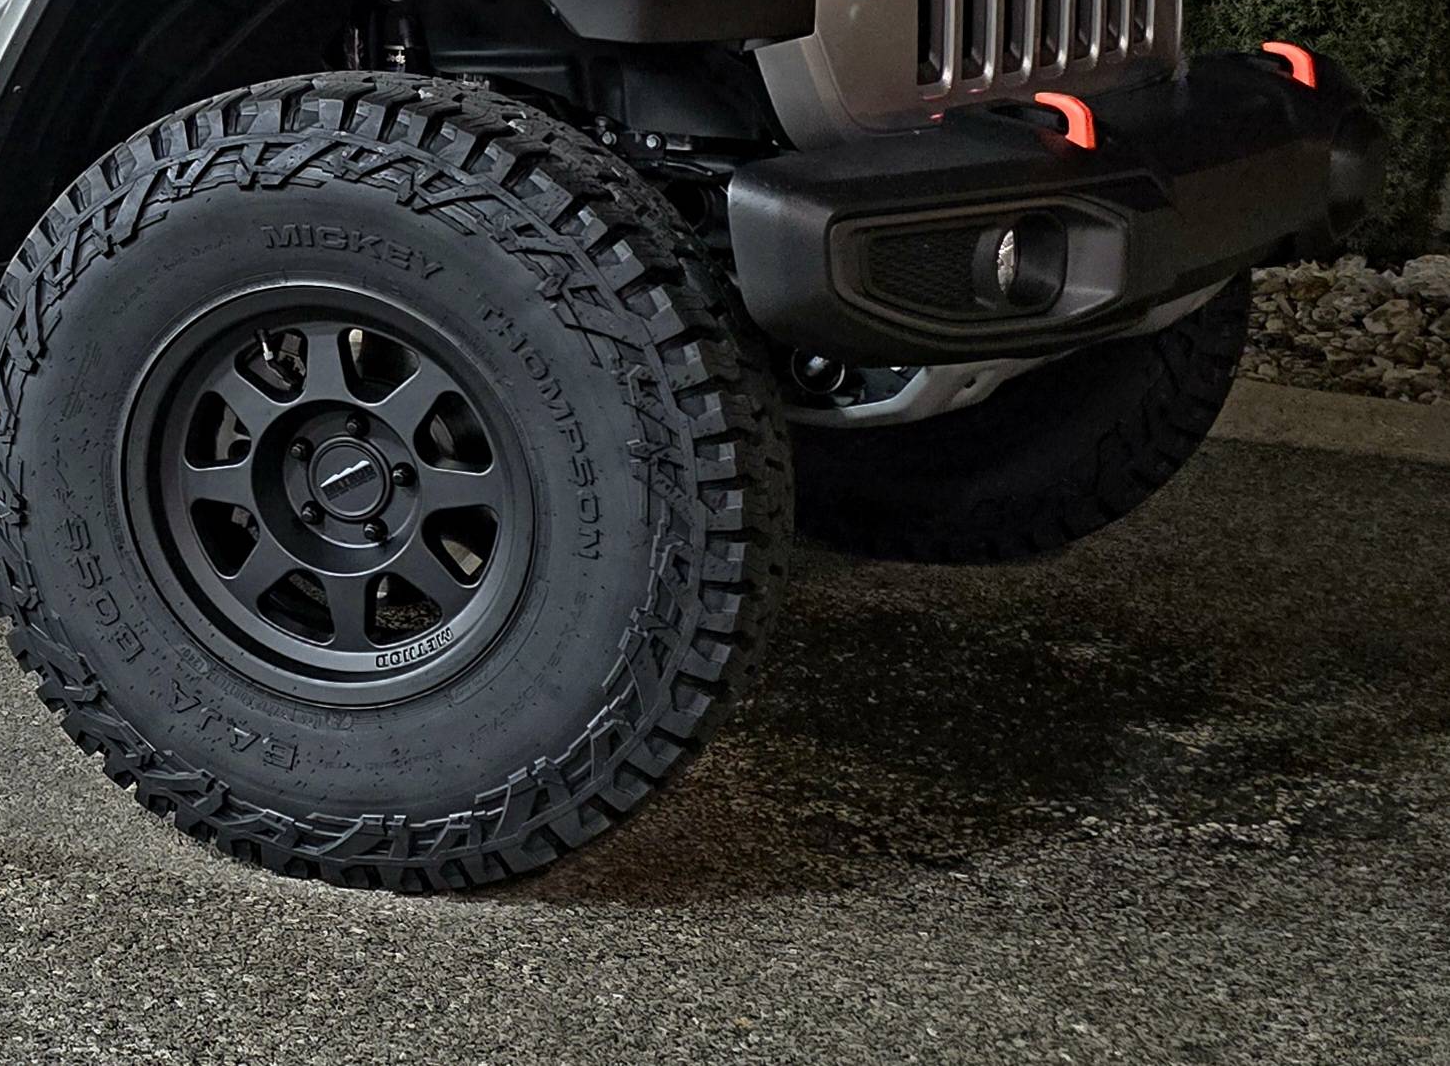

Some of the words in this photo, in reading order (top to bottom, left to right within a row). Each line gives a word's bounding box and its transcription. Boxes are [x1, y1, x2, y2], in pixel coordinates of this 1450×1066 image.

[260, 223, 445, 280] MICKEY
[477, 296, 602, 561] THOMPSON
[62, 517, 146, 664] BOSS
[375, 627, 455, 668] METHOD
[168, 678, 298, 771] BAJA
